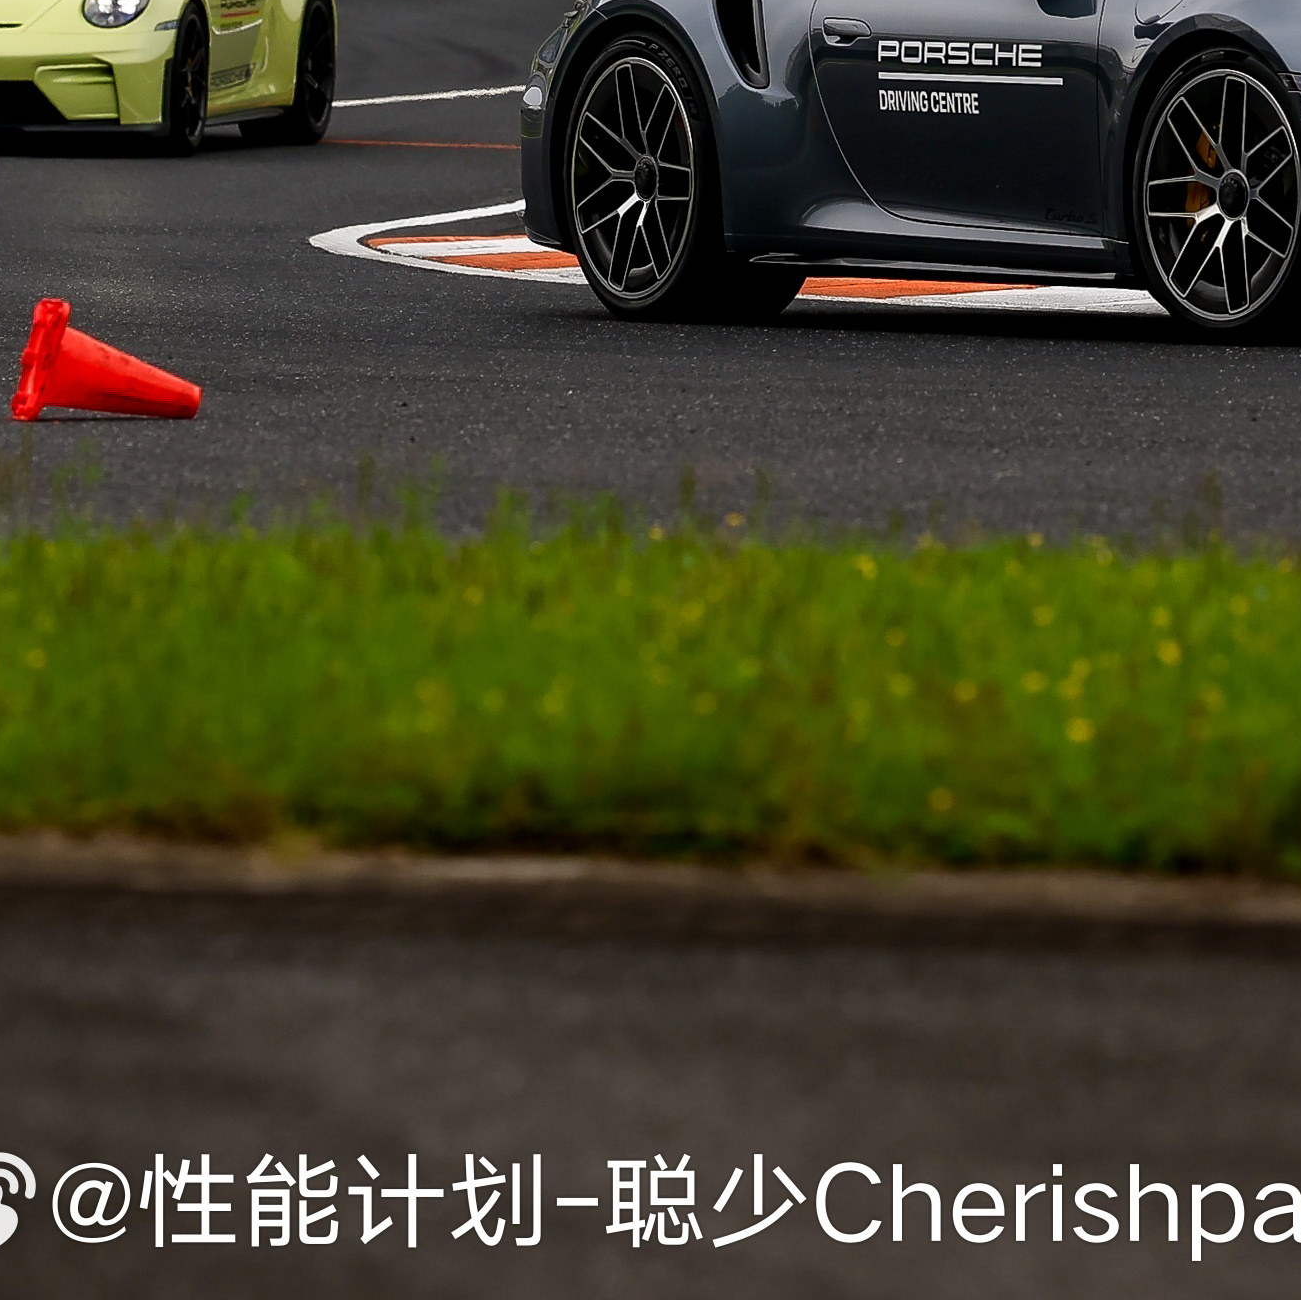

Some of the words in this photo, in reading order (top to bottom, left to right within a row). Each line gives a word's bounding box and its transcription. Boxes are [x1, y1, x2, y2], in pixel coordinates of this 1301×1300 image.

[878, 40, 1043, 67] PORSCHE
[657, 49, 687, 88] ZERO
[879, 90, 928, 112] DRIVING
[931, 91, 980, 115] CENTRE
